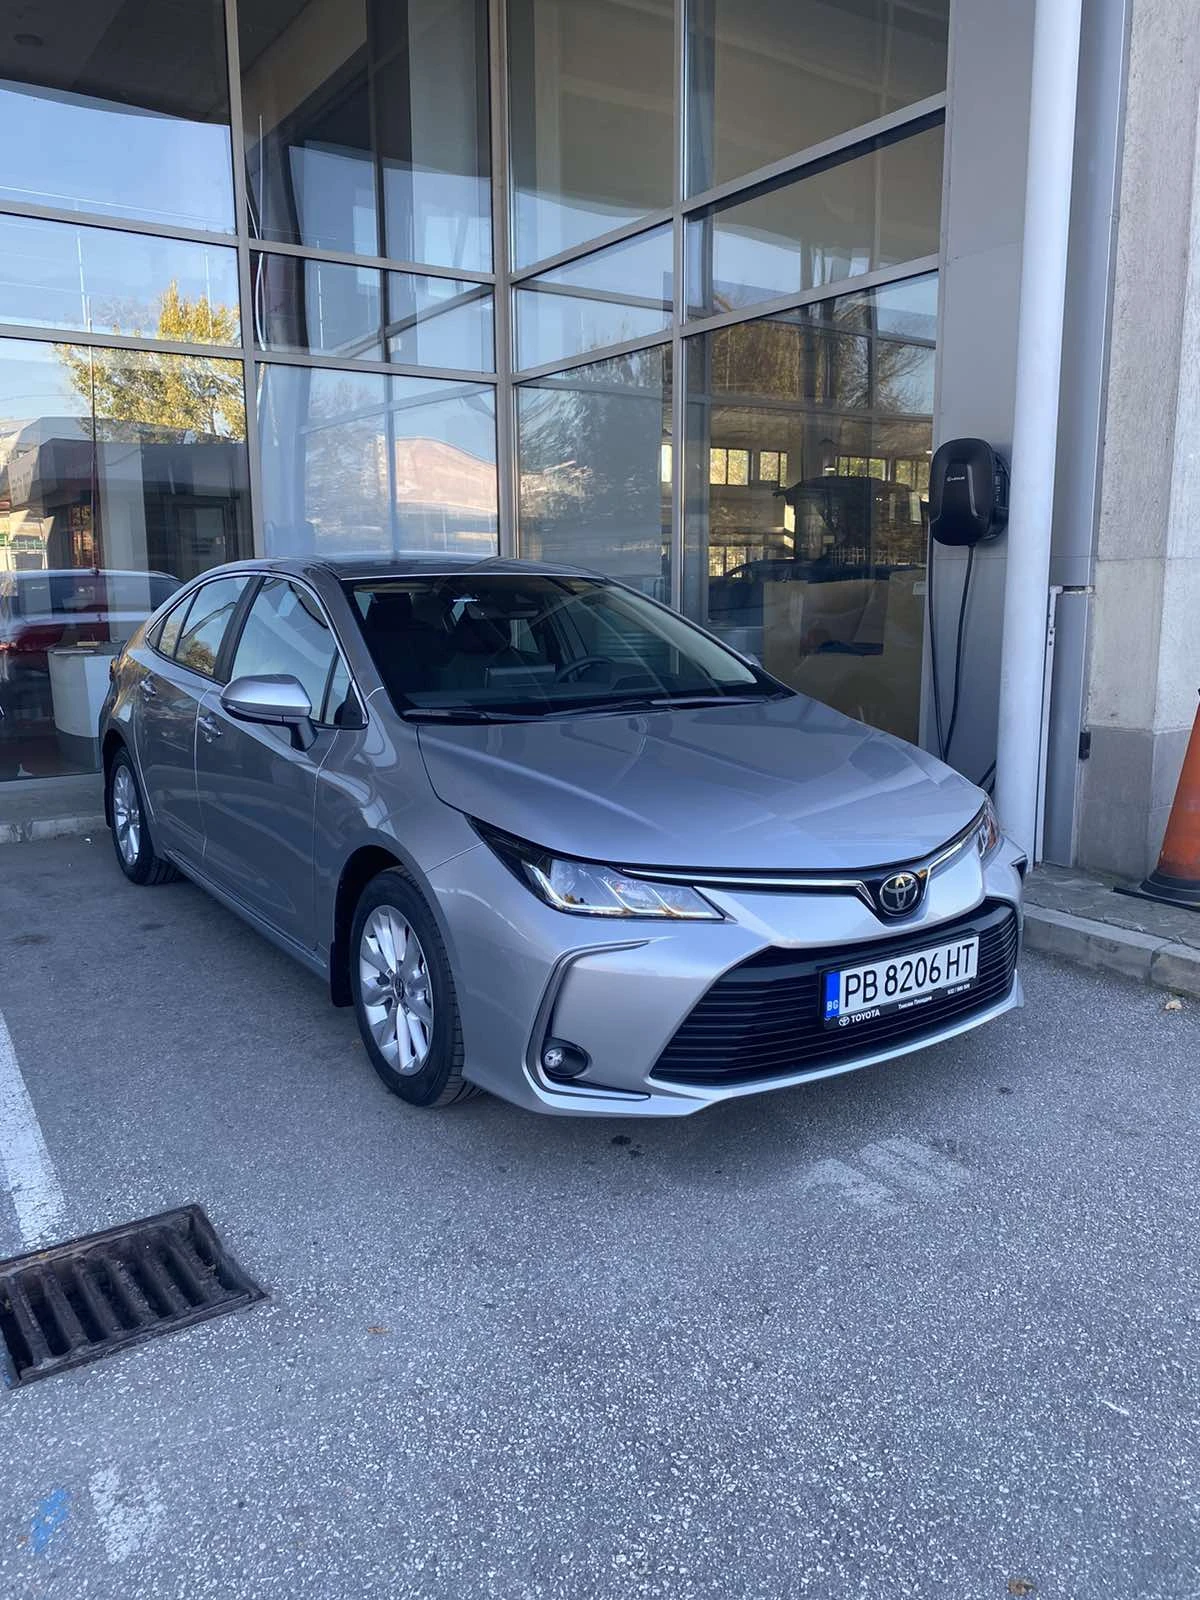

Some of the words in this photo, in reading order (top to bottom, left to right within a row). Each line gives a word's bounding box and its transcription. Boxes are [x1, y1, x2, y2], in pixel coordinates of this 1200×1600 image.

[844, 969, 878, 1008] PB
[884, 952, 941, 996] 8206
[946, 942, 975, 980] HT
[826, 999, 839, 1012] BG
[850, 1008, 881, 1023] TOYOTA
